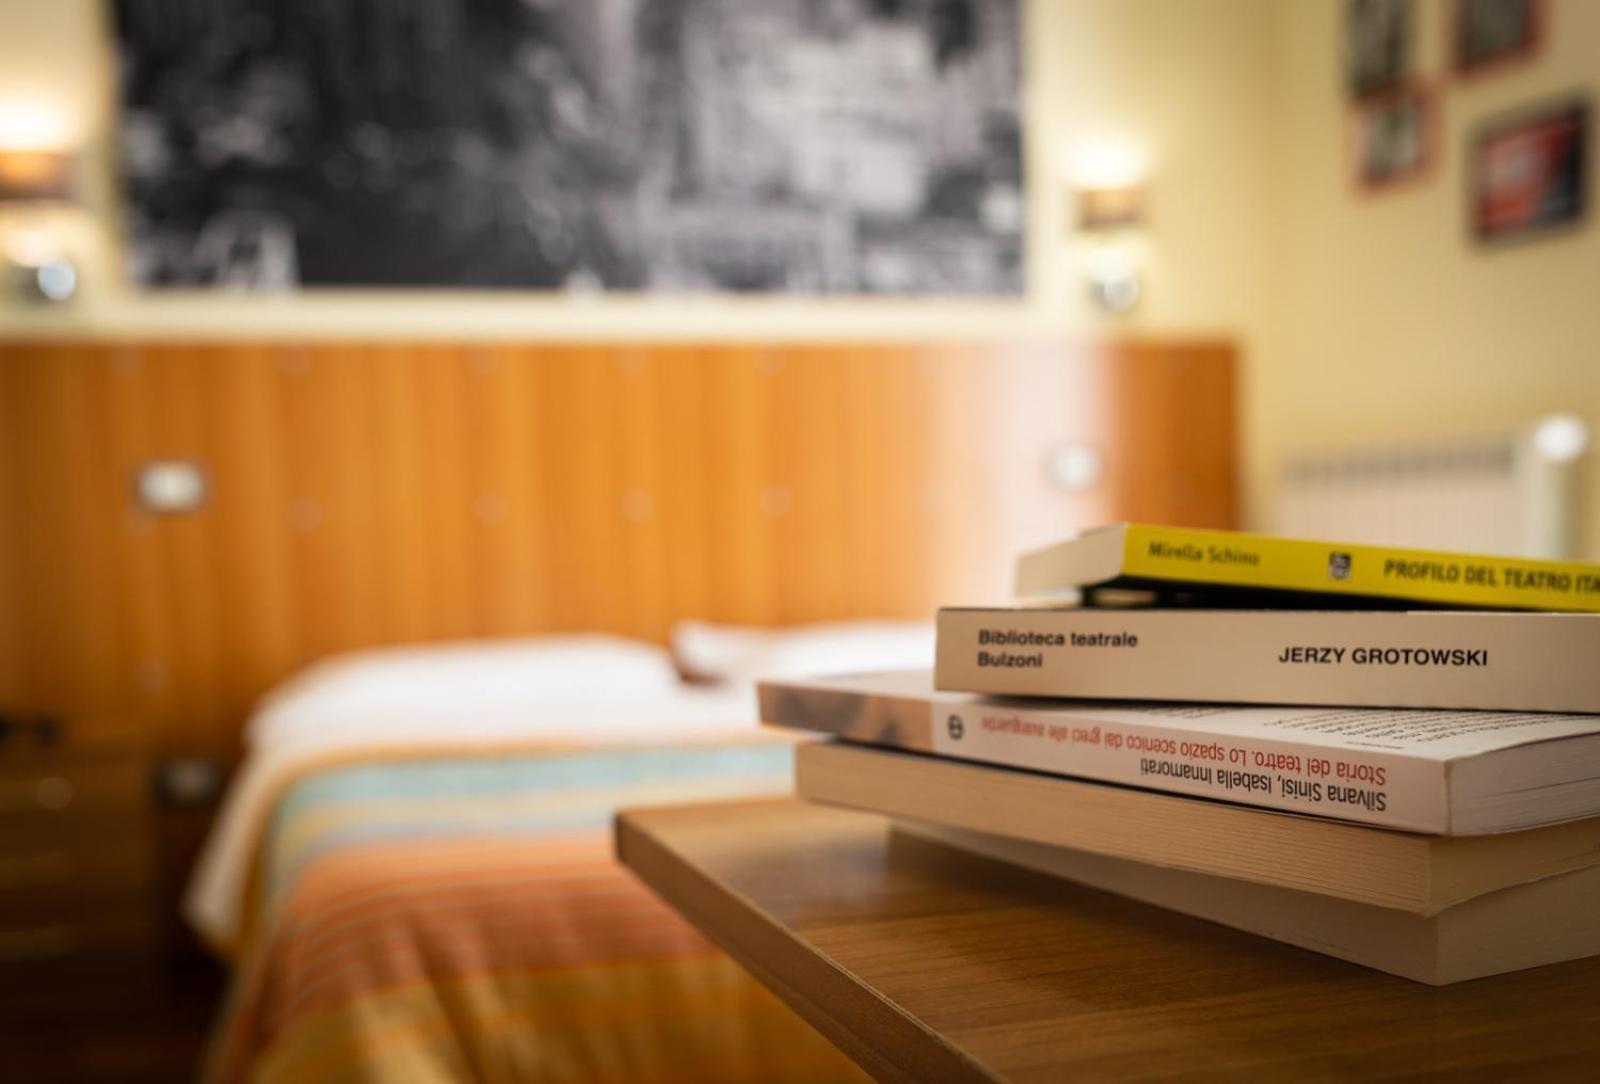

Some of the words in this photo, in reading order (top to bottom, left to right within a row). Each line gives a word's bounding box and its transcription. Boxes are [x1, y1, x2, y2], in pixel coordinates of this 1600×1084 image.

[1149, 541, 1203, 561] Mirella
[1207, 545, 1261, 566] Schino
[1384, 559, 1460, 582] PROFILO
[1464, 565, 1496, 586] DEL
[1504, 567, 1571, 591] TEATRO
[978, 629, 1065, 646] Biblioteca
[1071, 632, 1138, 647] teatrale
[977, 651, 1043, 668] Bulzoni
[1279, 647, 1345, 664] JERZY
[1352, 648, 1488, 666] GROTOWSKI
[1104, 731, 1123, 749] dai
[1127, 734, 1177, 755] scenico
[1180, 741, 1225, 762] spazio
[1229, 748, 1247, 766] Lo
[1251, 750, 1302, 774] teatro.
[1140, 757, 1212, 784] Innamorati
[1306, 757, 1331, 777] del
[1336, 758, 1386, 786] Storia
[1217, 767, 1272, 794] Isabella
[1277, 773, 1322, 802] Sinisi,
[1327, 782, 1387, 812] Silvana
